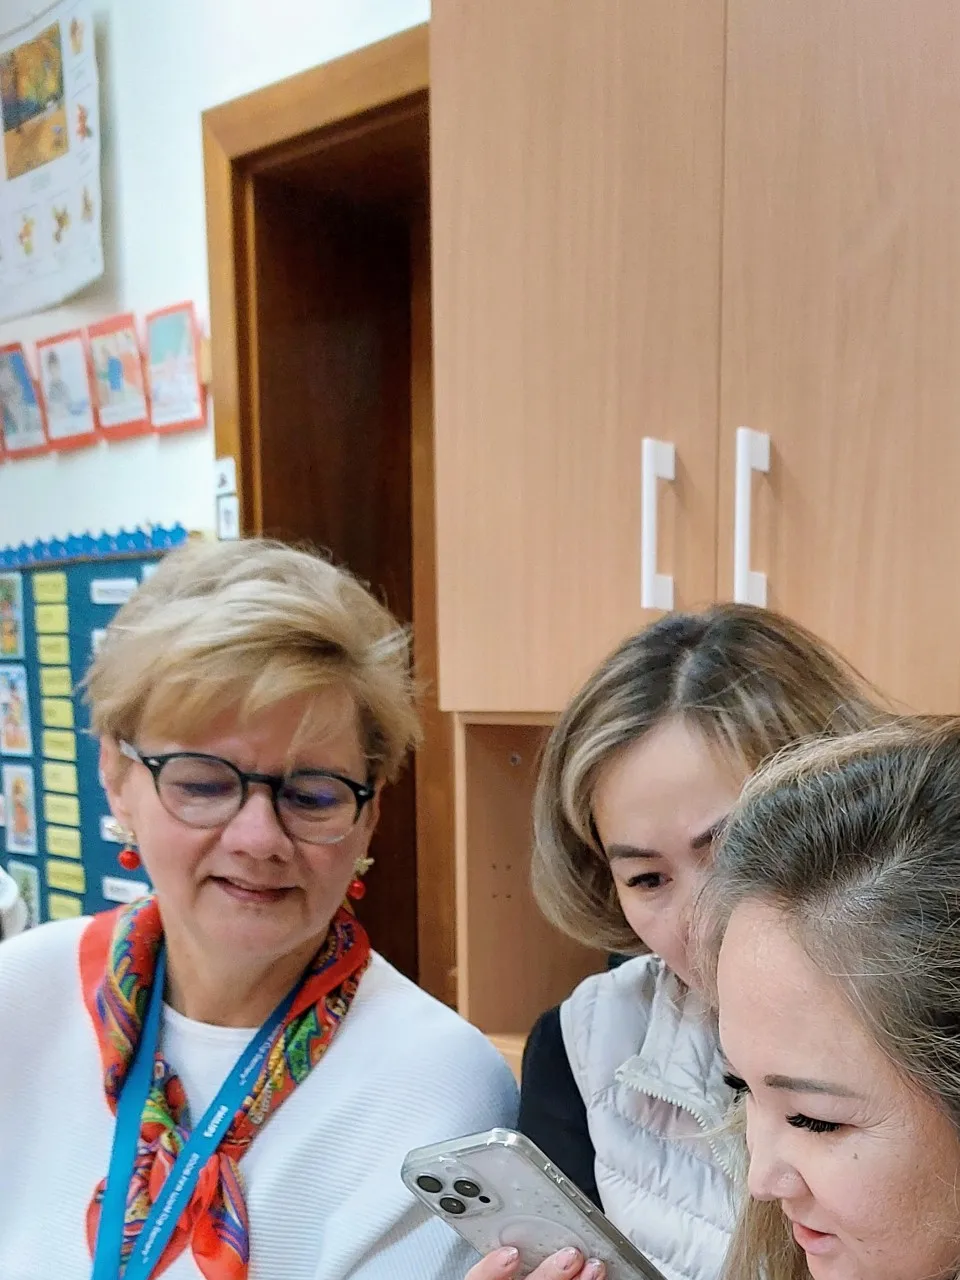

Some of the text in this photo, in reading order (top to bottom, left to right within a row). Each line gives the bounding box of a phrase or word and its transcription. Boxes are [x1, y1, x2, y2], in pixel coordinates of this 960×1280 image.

[203, 1105, 229, 1138] PHILIPS
[174, 1174, 188, 1192] FIFA
[163, 1191, 180, 1213] World
[154, 1211, 169, 1228] Cup
